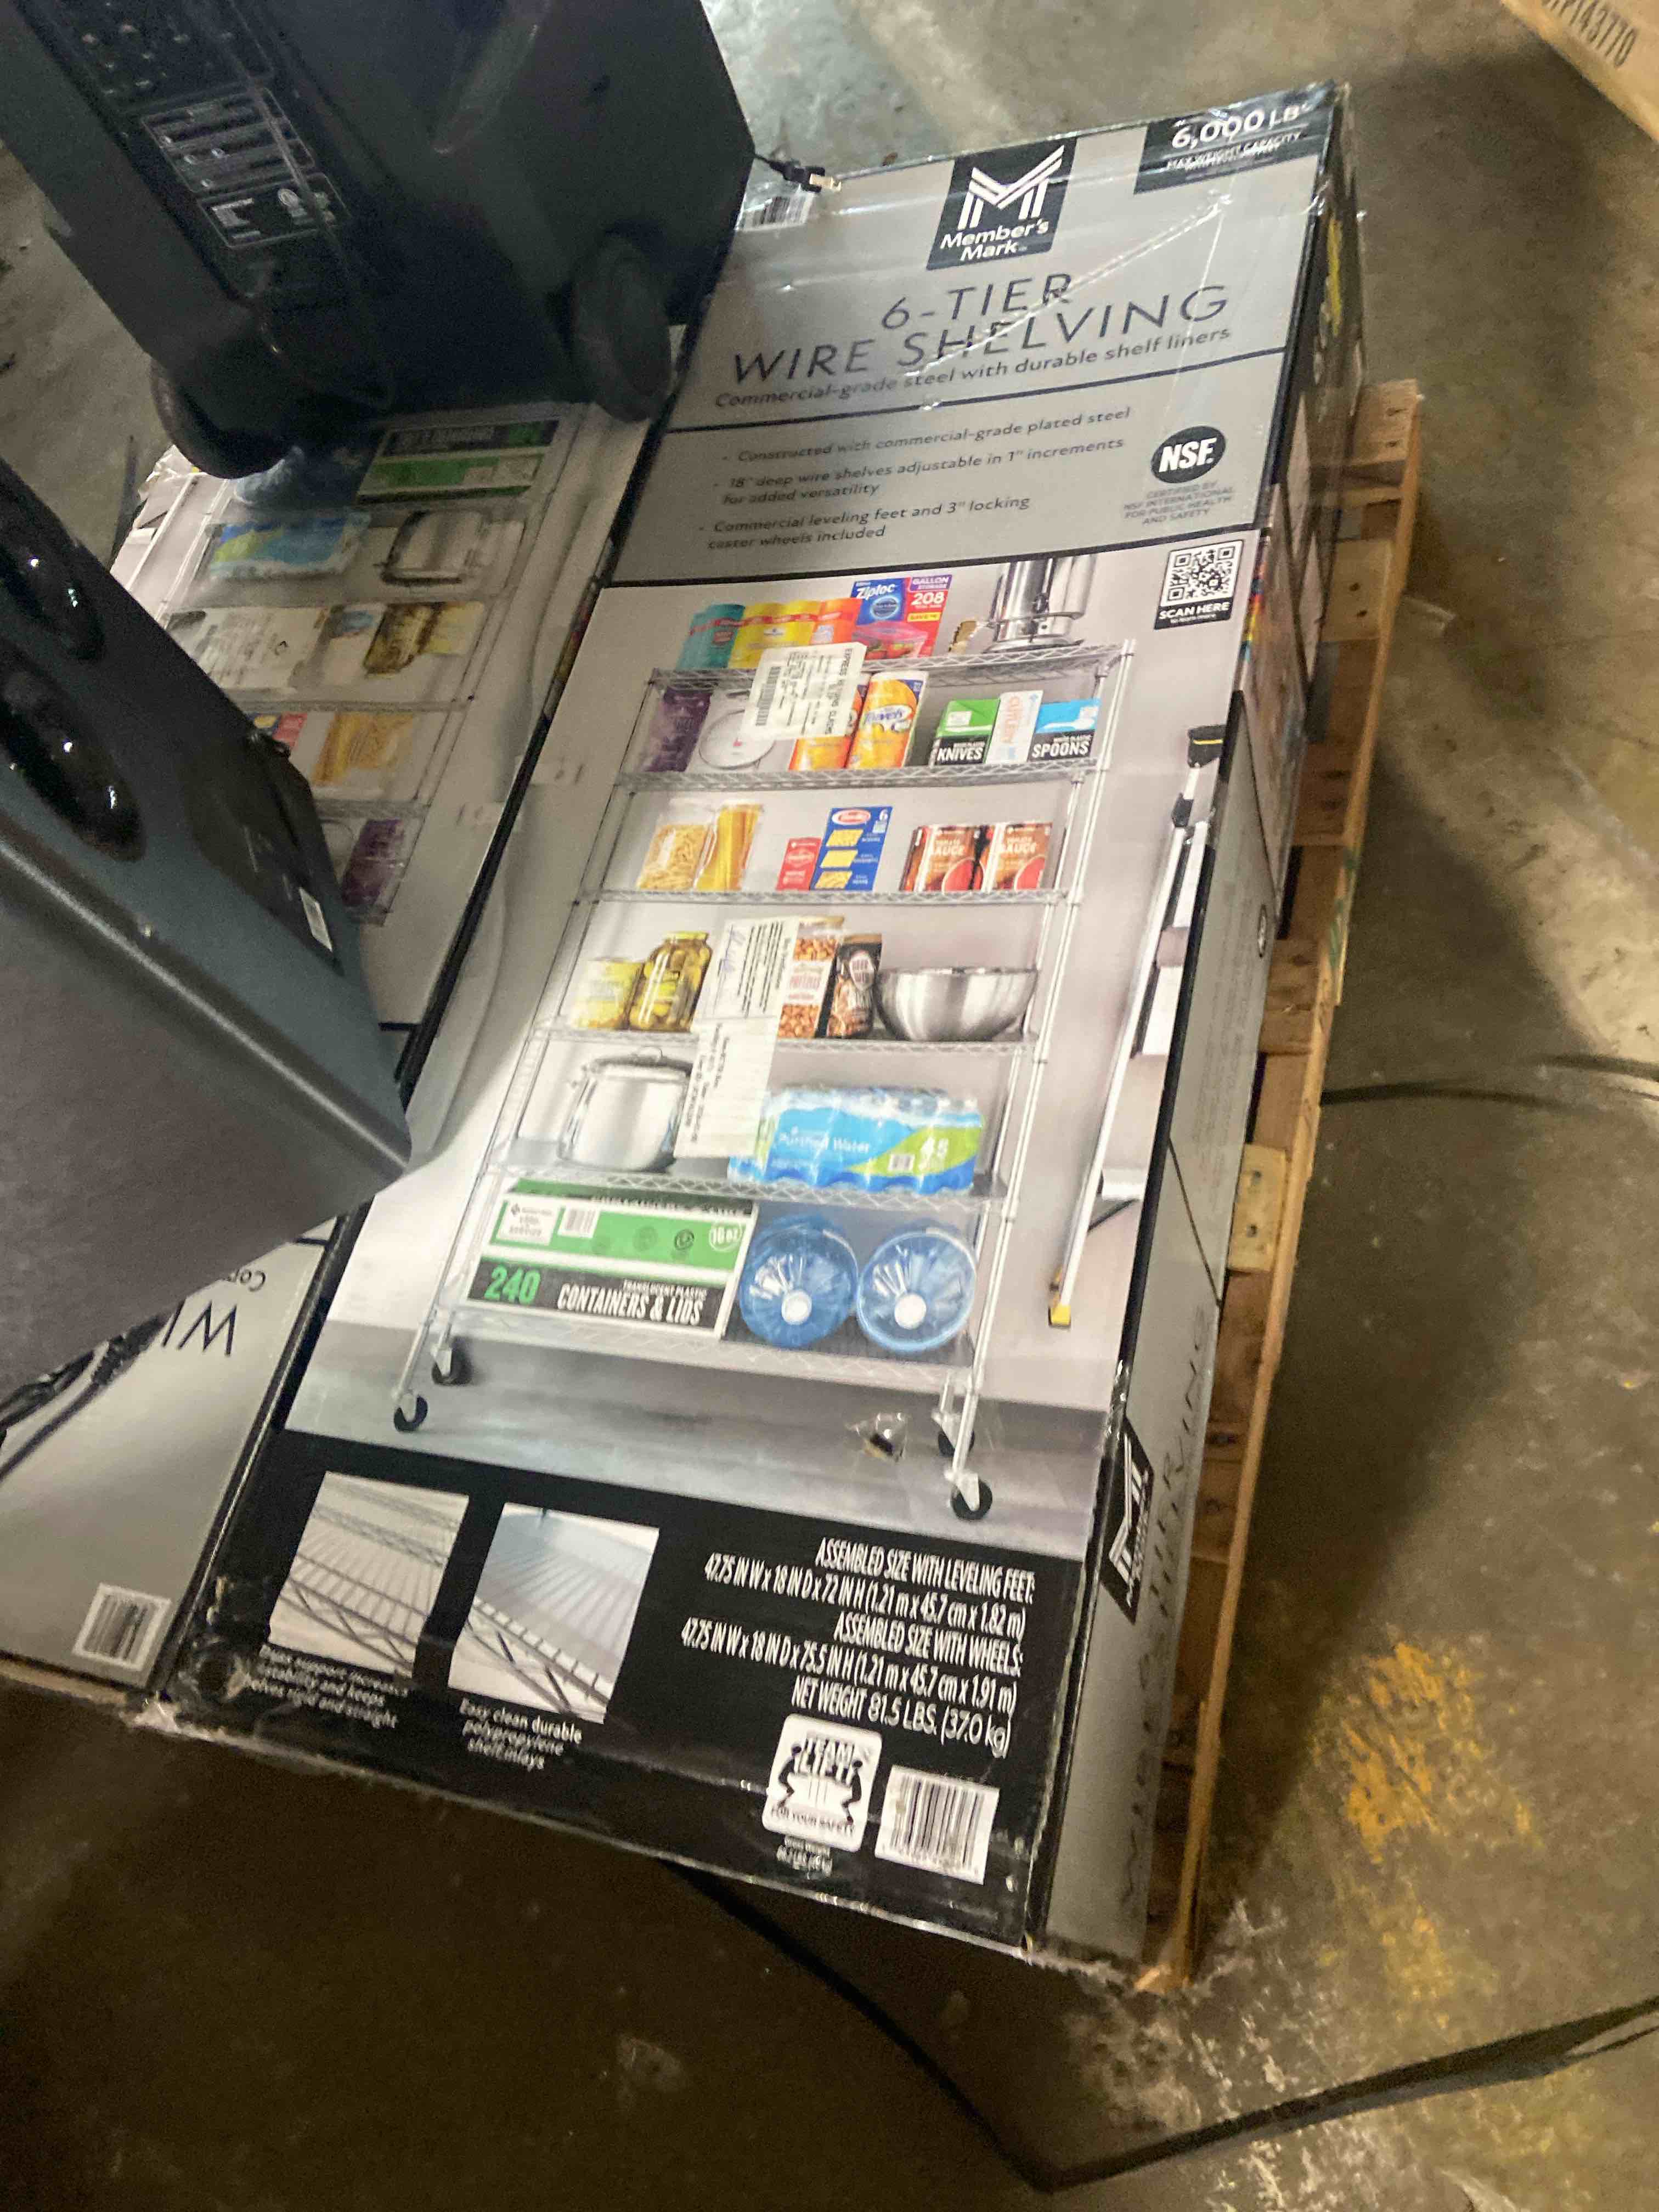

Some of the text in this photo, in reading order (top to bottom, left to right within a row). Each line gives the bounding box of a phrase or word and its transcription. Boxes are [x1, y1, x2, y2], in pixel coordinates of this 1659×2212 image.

[1172, 109, 1265, 150] 6,000
[939, 218, 1049, 251] Member's
[961, 239, 1021, 261] Mark
[882, 273, 1073, 329] 6-TIER
[732, 285, 1231, 384] WIRE SHELVING
[714, 326, 1231, 409] Commercial-grade steel with durable shelf liners
[738, 407, 1131, 461] Constructed with commercial-grade plated steel
[758, 475, 792, 486] deep
[800, 472, 828, 481] wire
[837, 466, 890, 478] shelves
[899, 457, 980, 473] adjustable
[989, 454, 1000, 462] in
[1010, 451, 1021, 460] 1"
[1028, 439, 1122, 458] increments
[1159, 437, 1217, 473] NSF
[752, 490, 797, 504] added
[801, 483, 879, 498] versatility
[714, 497, 1030, 532] Commercial leveling feet and 3" locking
[760, 533, 812, 545] wheels
[817, 525, 886, 543] included
[856, 583, 895, 601] Ziploc
[911, 591, 945, 606] 208
[912, 577, 950, 585] GALLON
[1159, 606, 1195, 620] SCAN
[1196, 602, 1231, 614] HERE
[936, 747, 984, 760] KNIVES
[1031, 742, 1090, 758] SPOONS
[878, 809, 889, 821] 6
[483, 1266, 540, 1305] 240
[556, 1282, 706, 1327] CONTAINERS & LIDS
[815, 1537, 1035, 1604] ASSEMBLED SIZE WITH LEVELING FEET:
[703, 1553, 1025, 1642] 47.75 IN W x 18 IN D x 72 IN H (1.21 m x 45.7 cm x 1.82 m)
[834, 1611, 1023, 1676] ASSEMBLED SIZE WITH WHEELS:
[679, 1617, 1017, 1717] 47.75 IN W x 18 IN D x 75.5 IN H (1.21 m x 45.7 cm x 1.91 m)
[493, 1707, 529, 1729] clean
[531, 1716, 583, 1743] durable
[791, 1678, 1010, 1758] NET WEIGHT 81.5 LBS. (37.0 kg)
[788, 1809, 818, 1827] YOUR
[819, 1817, 855, 1838] SAFETY
